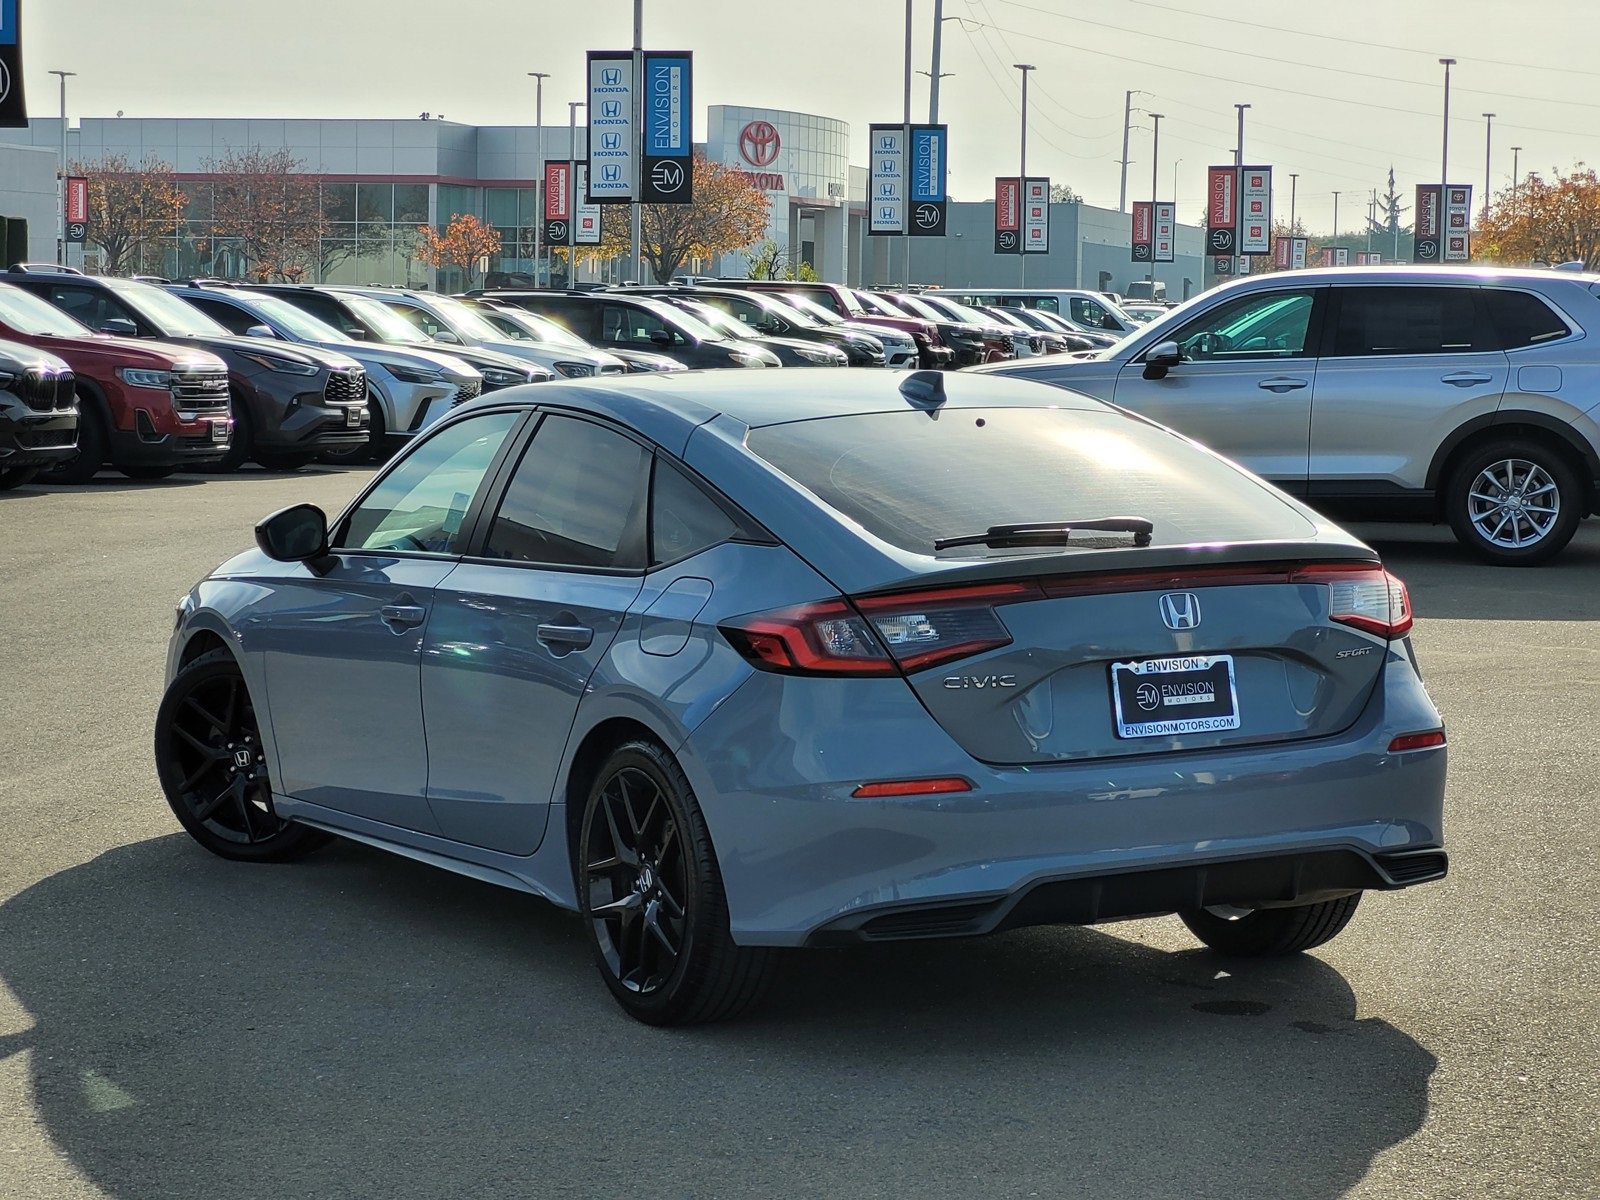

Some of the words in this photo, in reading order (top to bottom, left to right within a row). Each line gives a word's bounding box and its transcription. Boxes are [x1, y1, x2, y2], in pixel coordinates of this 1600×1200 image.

[654, 66, 669, 148] ENVISION
[918, 135, 930, 195] ENVISION
[551, 168, 559, 215] ENVISION
[1001, 184, 1009, 227] ENVISION
[1214, 174, 1224, 224] ENVISION
[1421, 192, 1430, 236] ENVISION
[1146, 658, 1199, 672] ENVISION
[1336, 646, 1373, 659] SPORT
[944, 674, 1016, 688] CIVIC
[1162, 682, 1215, 697] ENVISION
[1167, 694, 1211, 703] MOTORS
[1125, 718, 1235, 736] ENVISIONMOTORS.COM
